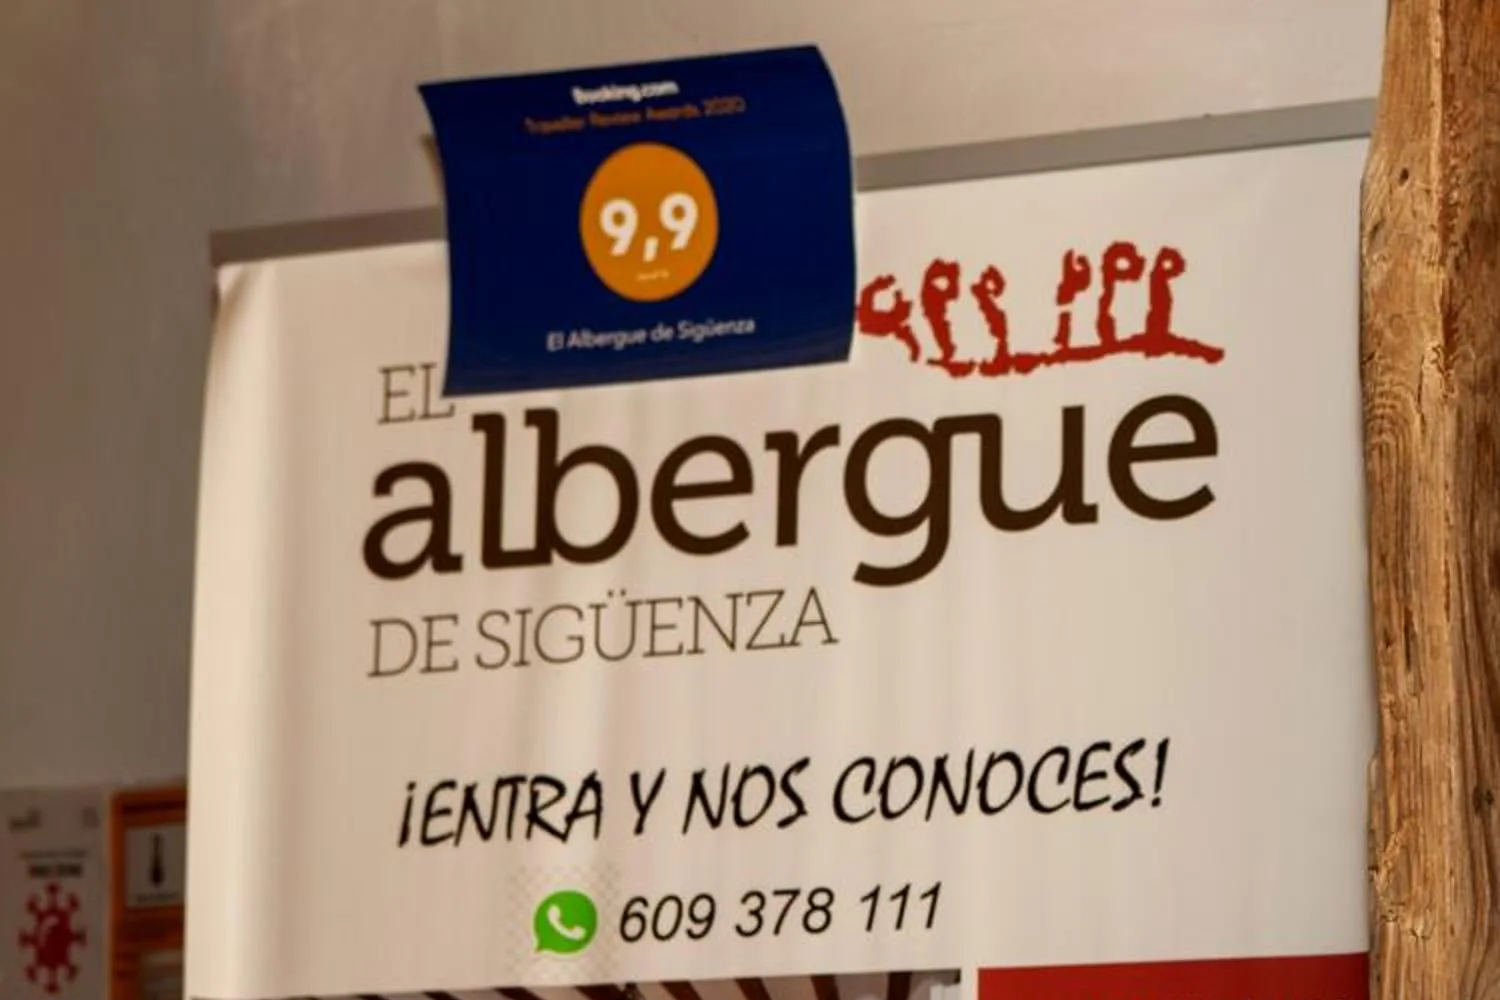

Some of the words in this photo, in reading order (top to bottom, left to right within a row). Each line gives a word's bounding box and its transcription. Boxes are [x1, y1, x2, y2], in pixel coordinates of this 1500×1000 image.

[599, 192, 698, 262] 9,9
[546, 330, 565, 350] El
[567, 326, 647, 350] Albergue
[651, 321, 674, 342] de
[677, 318, 756, 343] Sigüenza
[376, 364, 455, 424] EL
[362, 395, 1219, 587] albergue
[367, 613, 459, 678] DE
[475, 586, 838, 671] SIGÜENZA
[398, 770, 603, 848] ¡ENTRA
[630, 769, 666, 836] Y
[682, 756, 810, 836] NOS
[832, 737, 1172, 824] CONOCES!
[619, 893, 716, 942] 609
[735, 887, 833, 936] 378
[860, 882, 943, 932] 111
